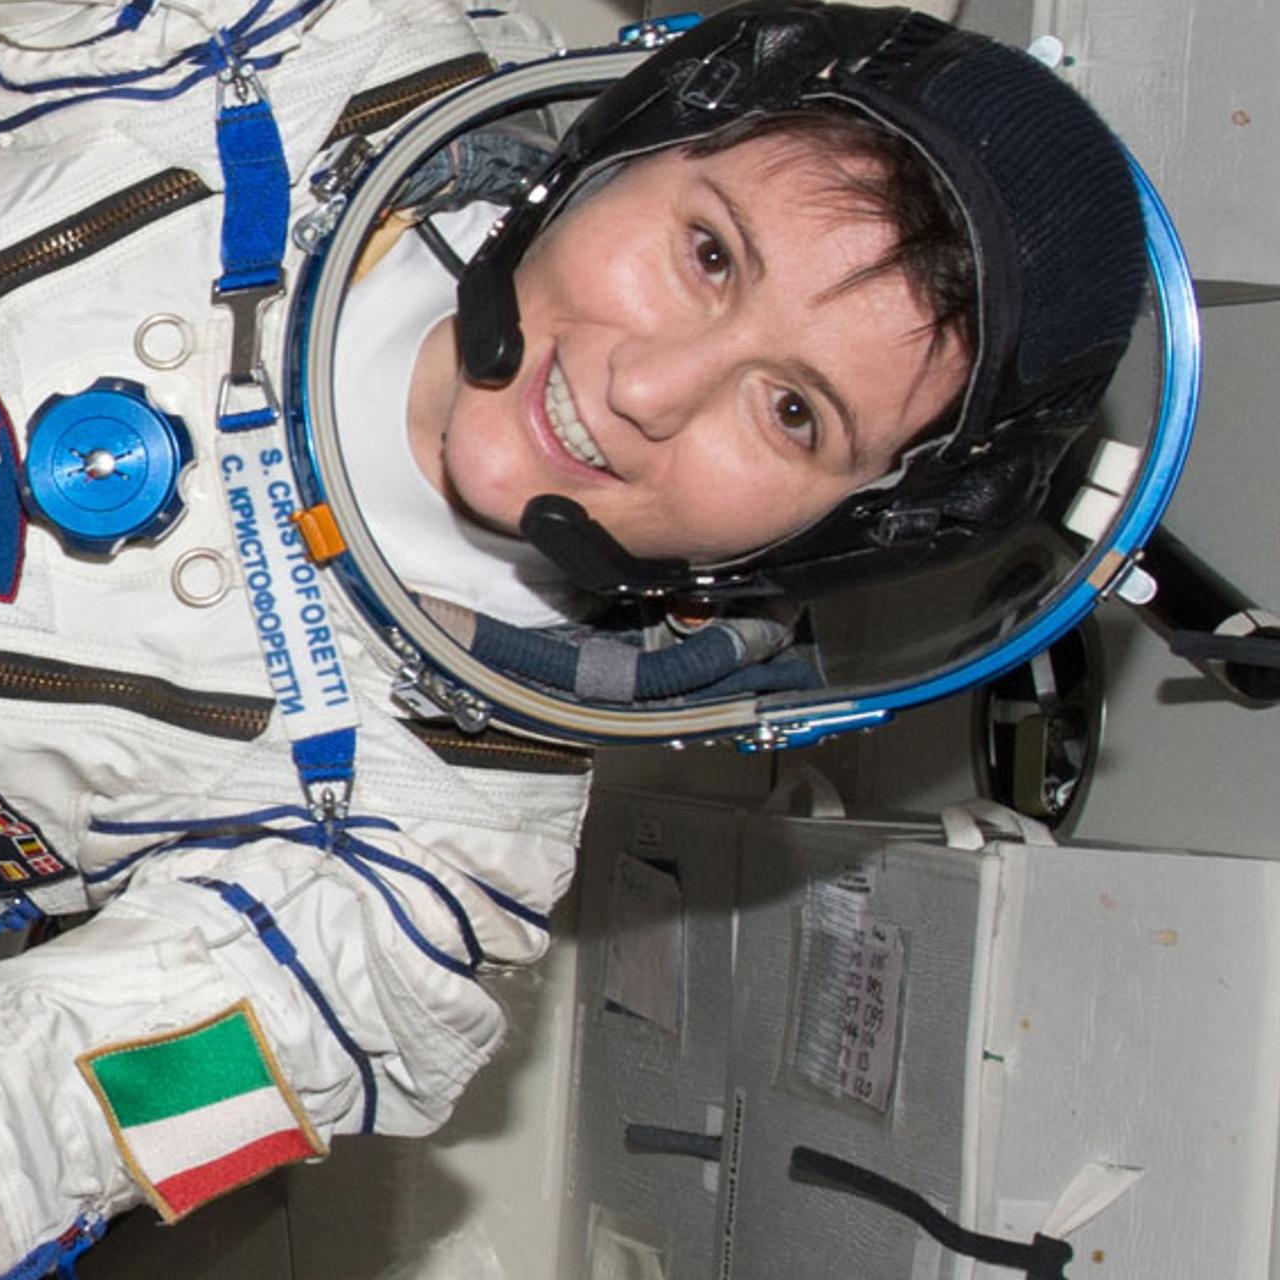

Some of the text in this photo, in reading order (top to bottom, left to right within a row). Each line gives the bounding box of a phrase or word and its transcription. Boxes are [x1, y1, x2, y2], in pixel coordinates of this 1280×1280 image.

[227, 486, 306, 716] КРИСТОФОРЕТТИ
[259, 448, 350, 708] S. CRISTOFORETTI
